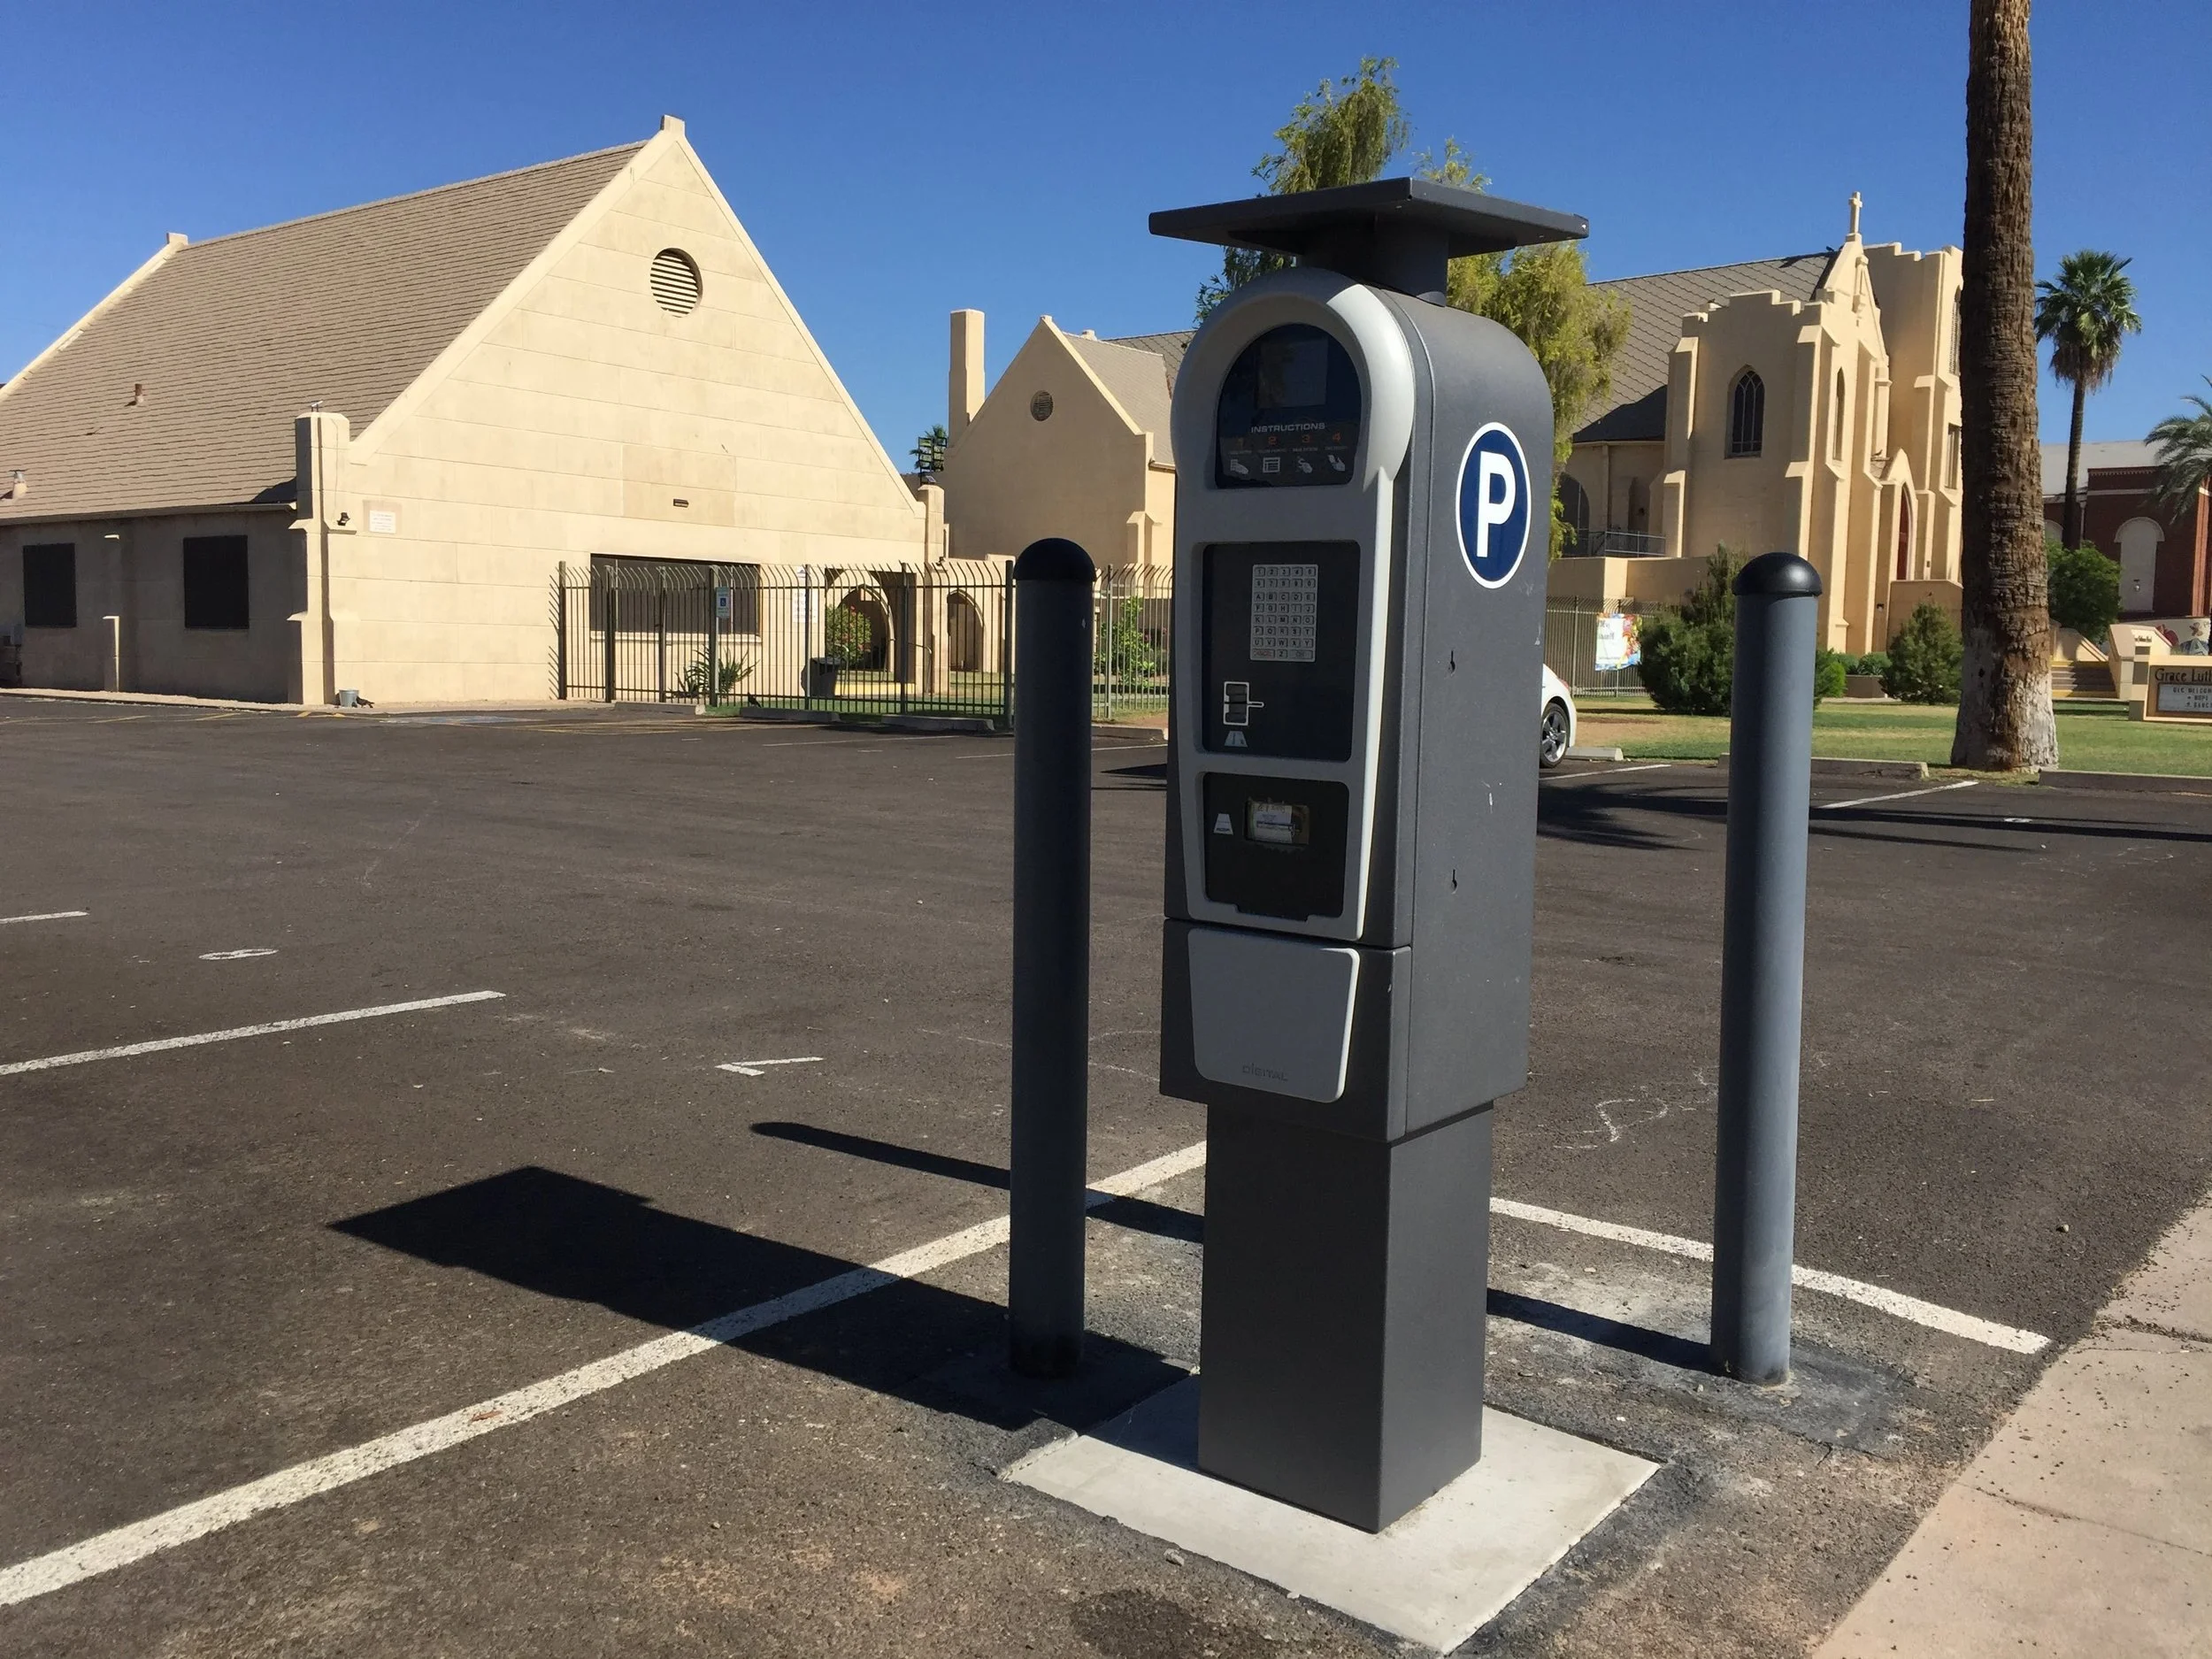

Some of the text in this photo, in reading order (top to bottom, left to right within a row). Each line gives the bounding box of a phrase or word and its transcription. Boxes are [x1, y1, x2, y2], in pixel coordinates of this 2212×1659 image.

[1251, 422, 1325, 434] INSTRUCTIONS
[1302, 434, 1310, 443] 3
[1477, 451, 1516, 557] P
[2155, 668, 2186, 681] Grace
